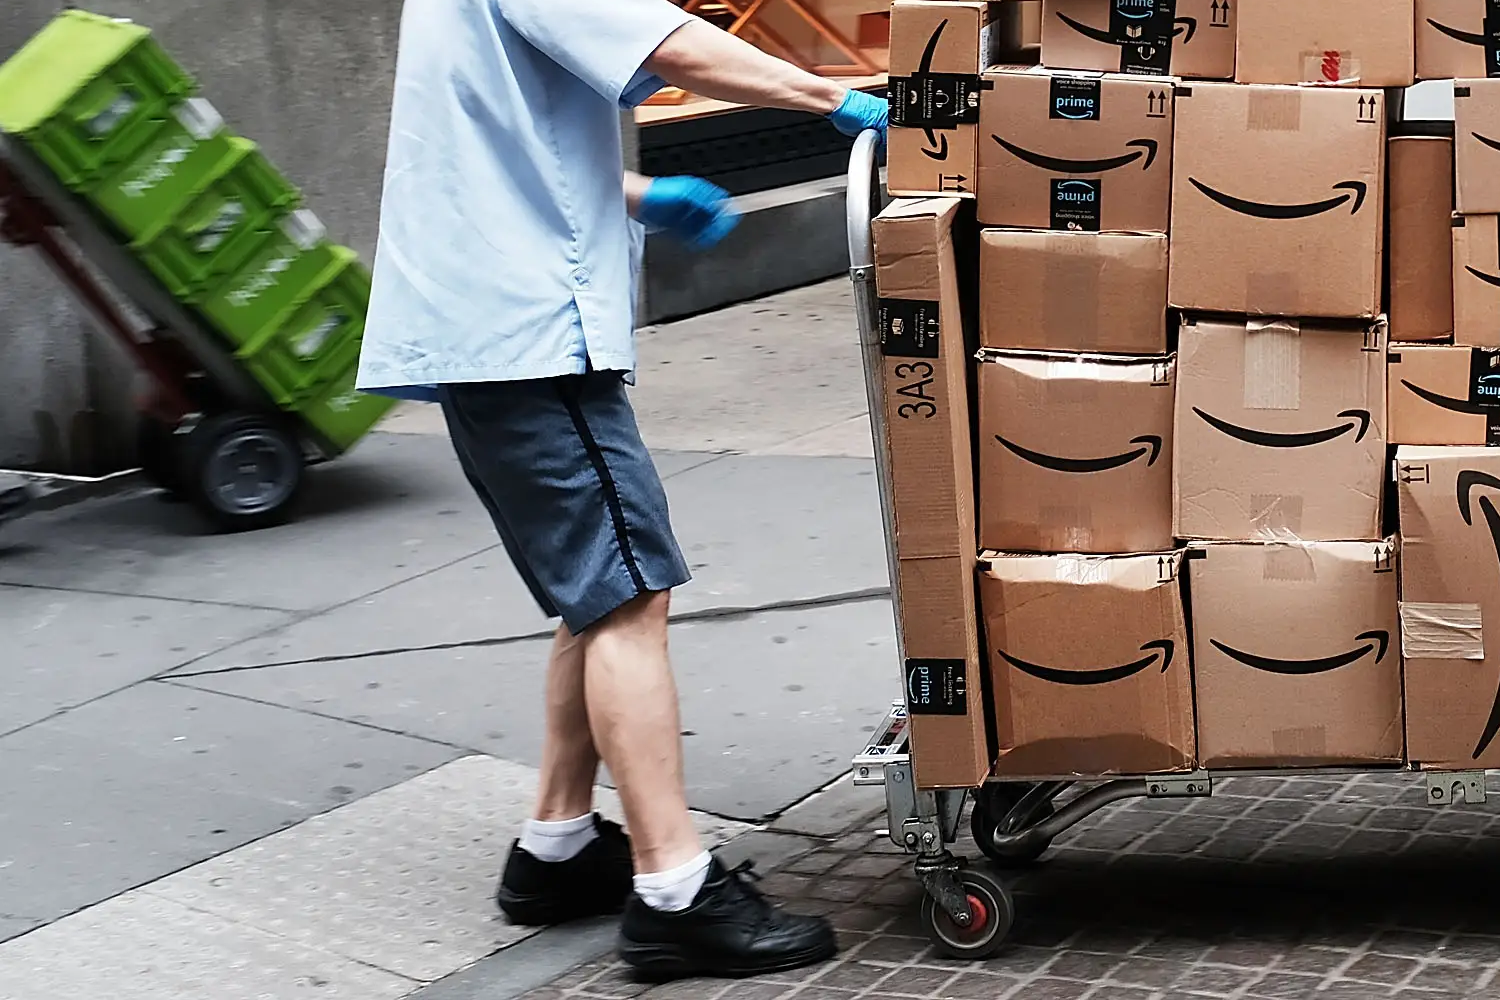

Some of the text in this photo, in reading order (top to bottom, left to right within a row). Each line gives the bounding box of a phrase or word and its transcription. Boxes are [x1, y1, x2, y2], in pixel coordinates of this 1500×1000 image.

[1056, 95, 1095, 109] prime
[1057, 190, 1095, 205] prime
[895, 361, 936, 419] 3A3
[918, 666, 933, 704] prime
